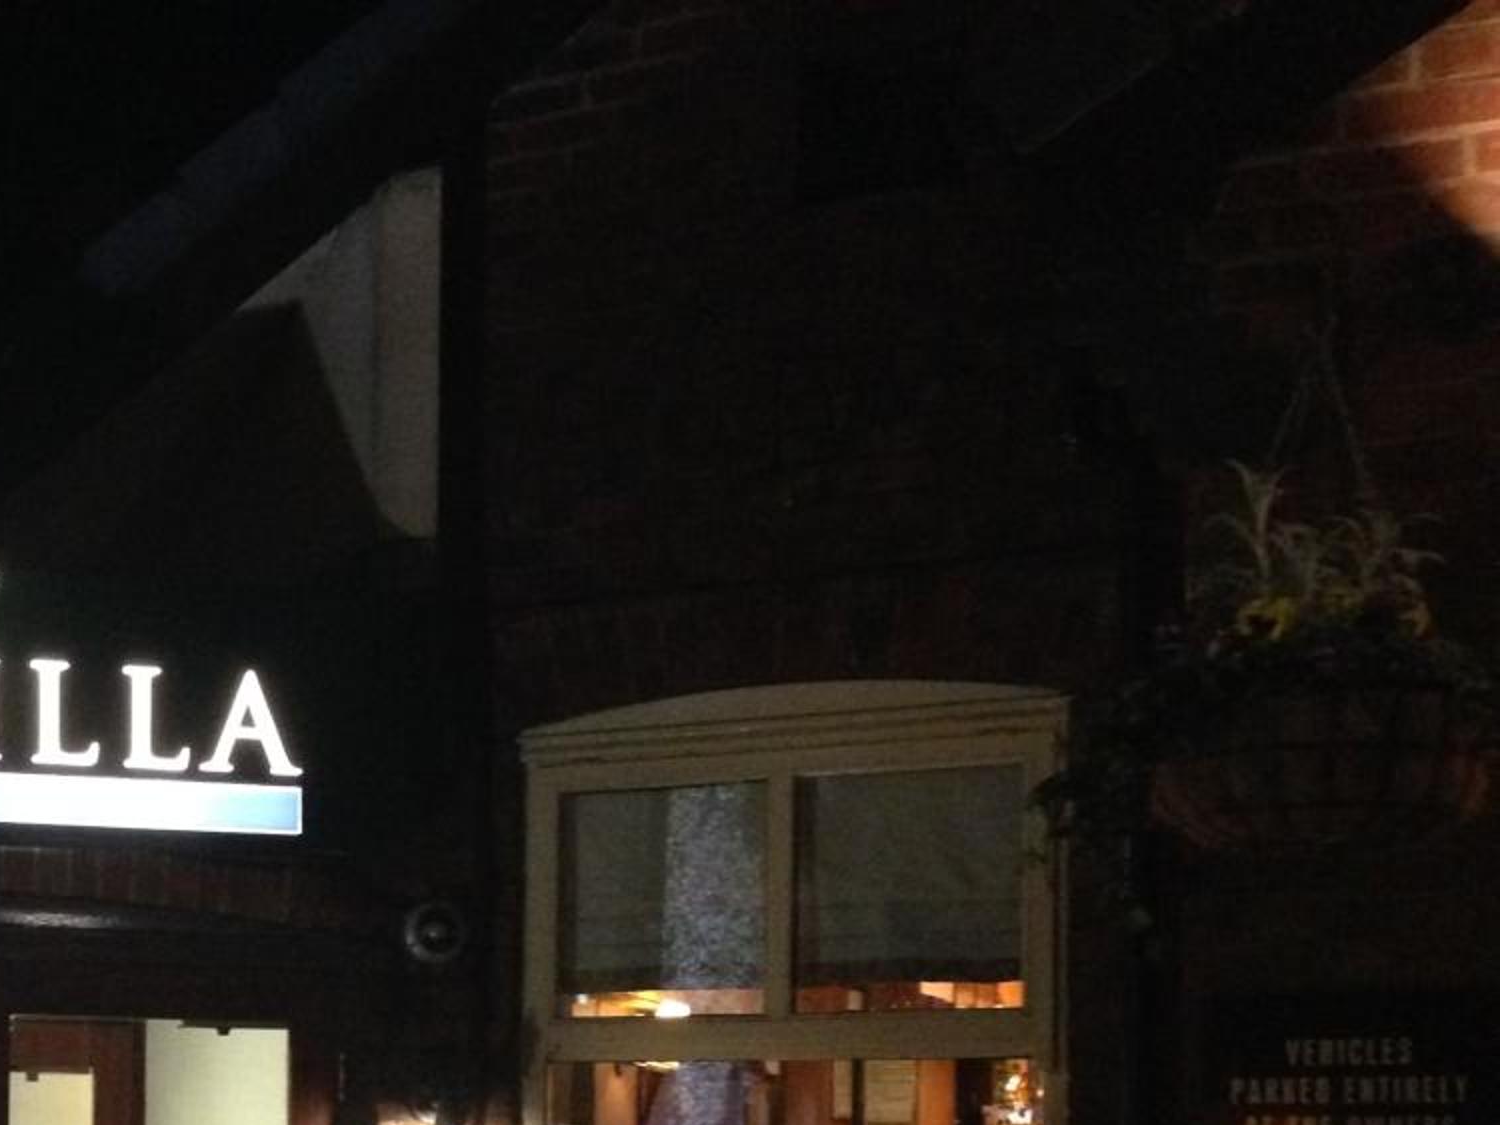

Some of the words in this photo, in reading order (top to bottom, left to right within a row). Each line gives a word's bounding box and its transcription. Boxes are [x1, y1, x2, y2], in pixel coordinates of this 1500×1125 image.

[1284, 1038, 1413, 1067] VEHICLES
[1229, 1076, 1331, 1104] PARKED
[1343, 1075, 1469, 1104] ENTIRELY
